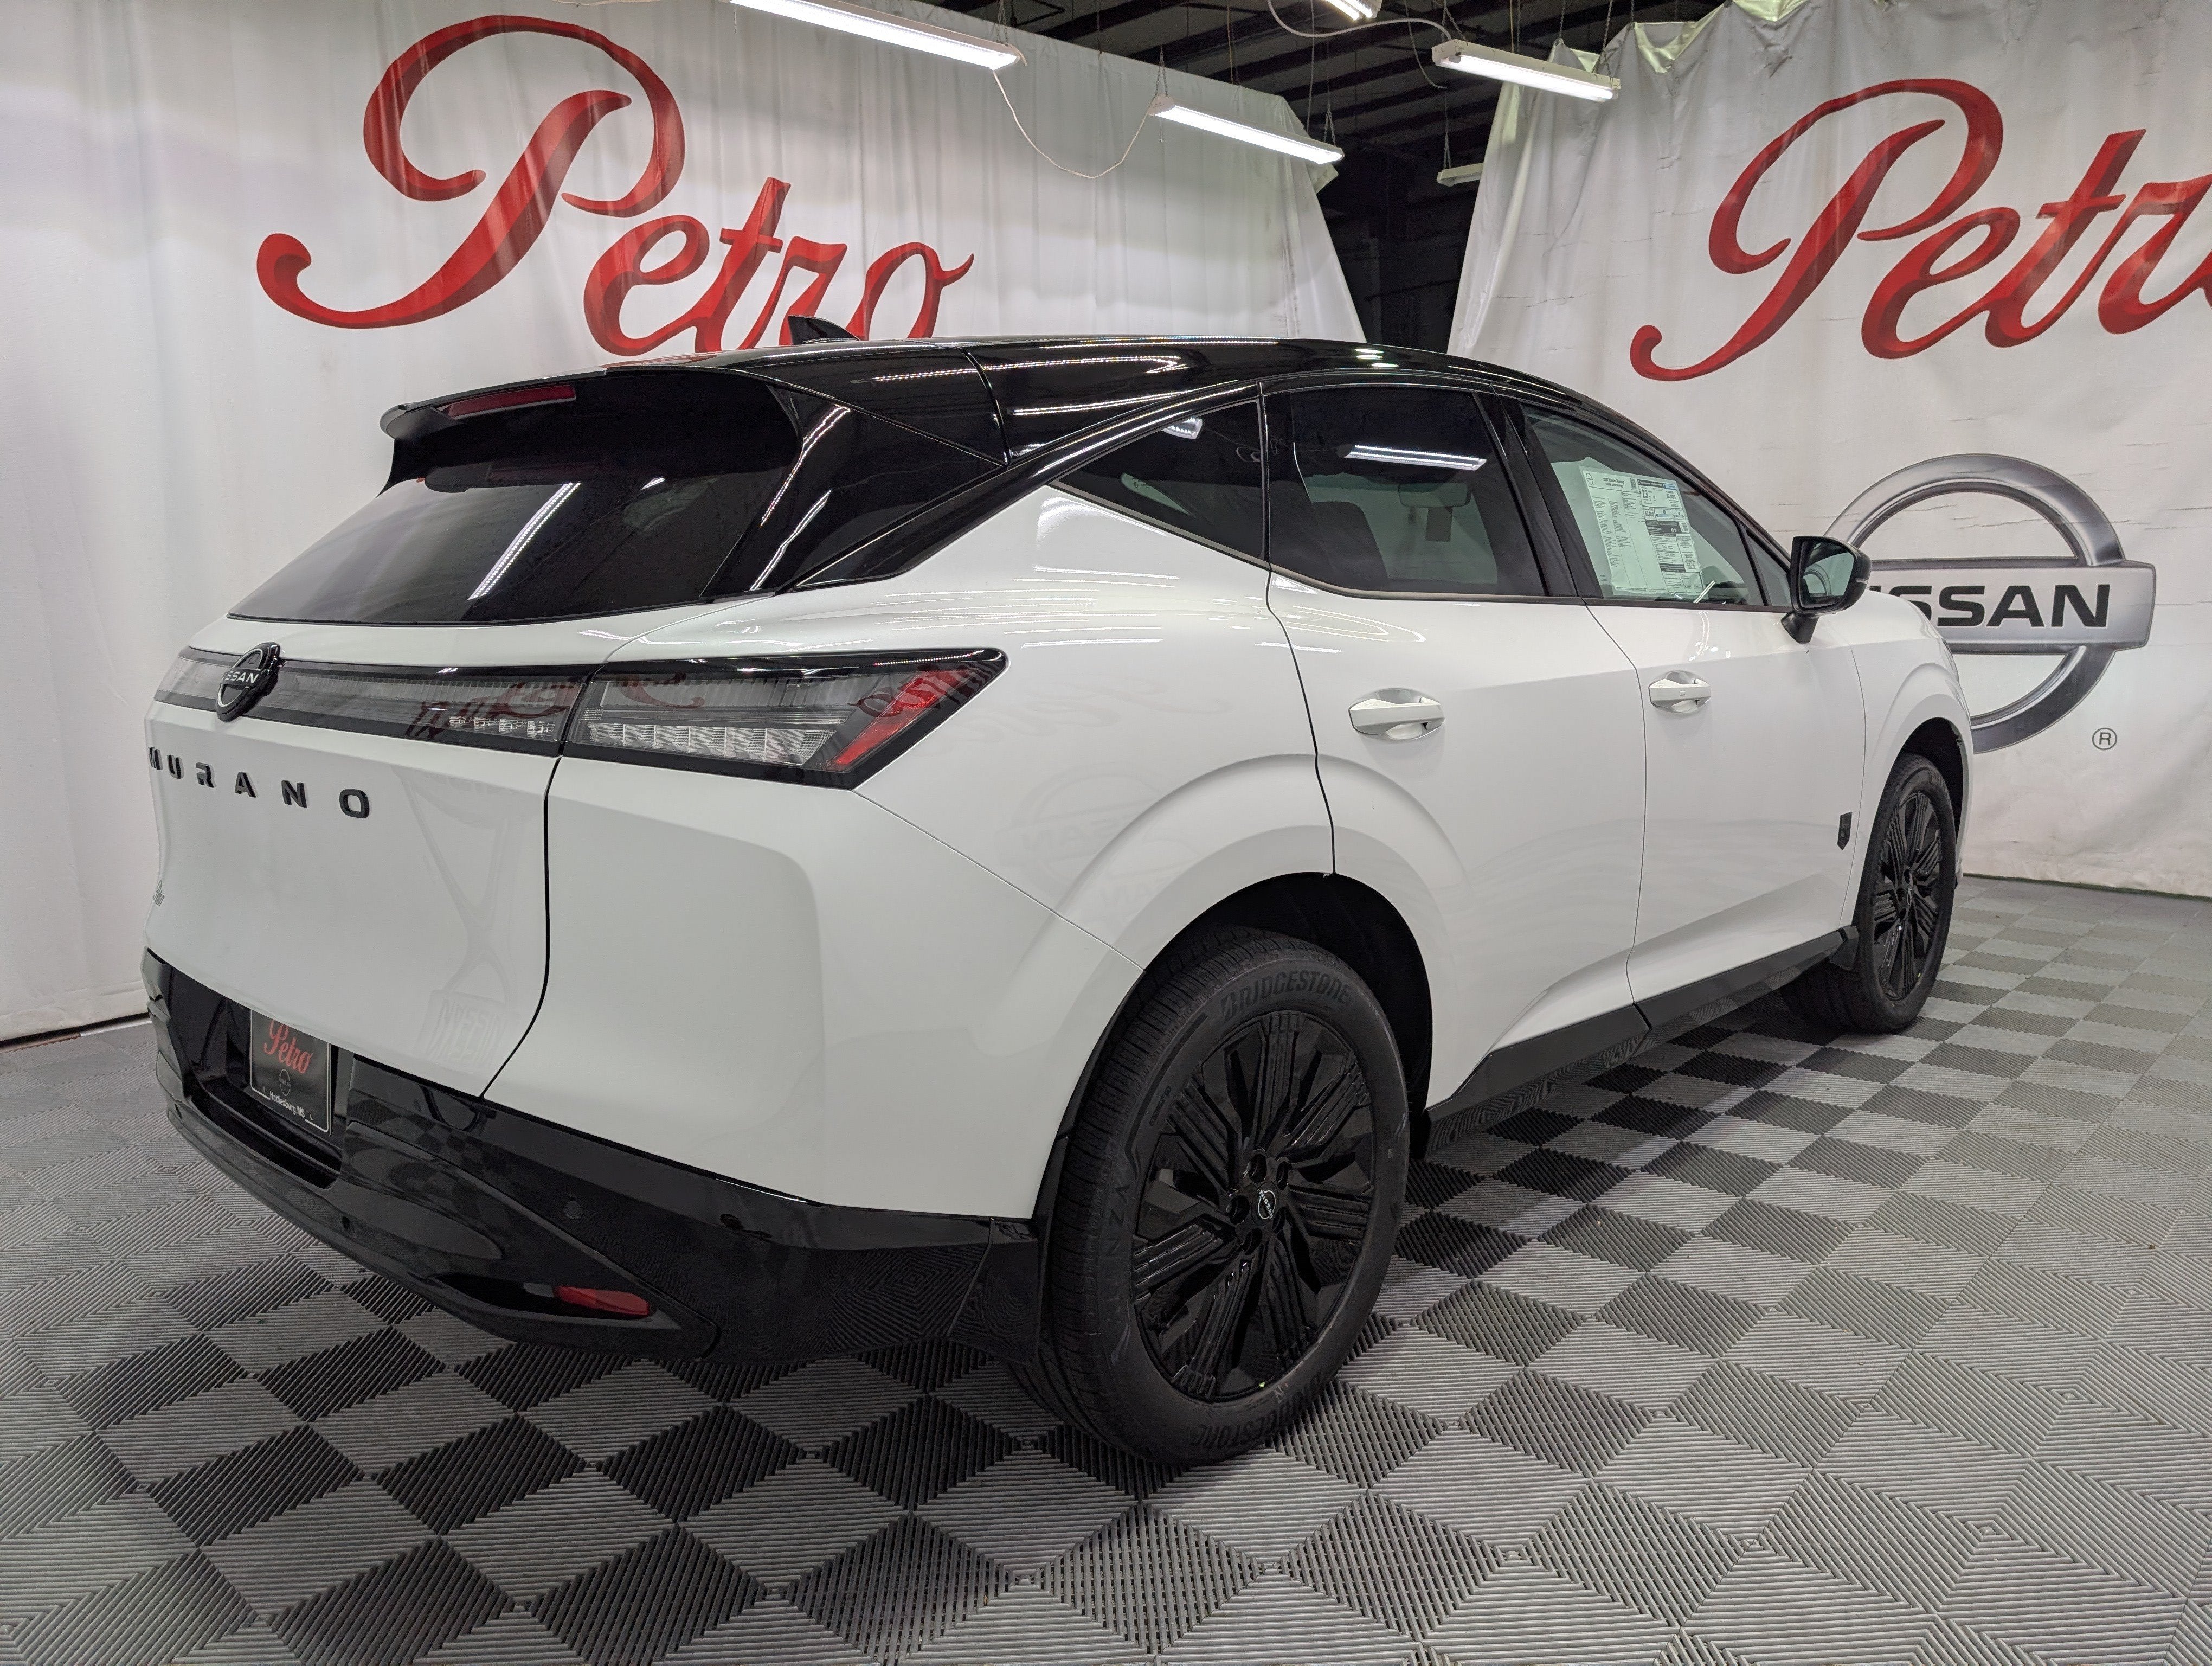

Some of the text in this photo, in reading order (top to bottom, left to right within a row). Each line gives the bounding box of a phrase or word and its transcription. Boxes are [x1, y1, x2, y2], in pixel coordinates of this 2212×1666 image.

[256, 15, 974, 356] Petro
[1630, 78, 2212, 382] Petr
[1869, 584, 2111, 628] SSAN
[223, 671, 259, 683] SSAN
[1220, 969, 1351, 1024] BRIDGESTONE
[263, 1020, 313, 1073] Petro
[1257, 1189, 1274, 1219] NISSAN
